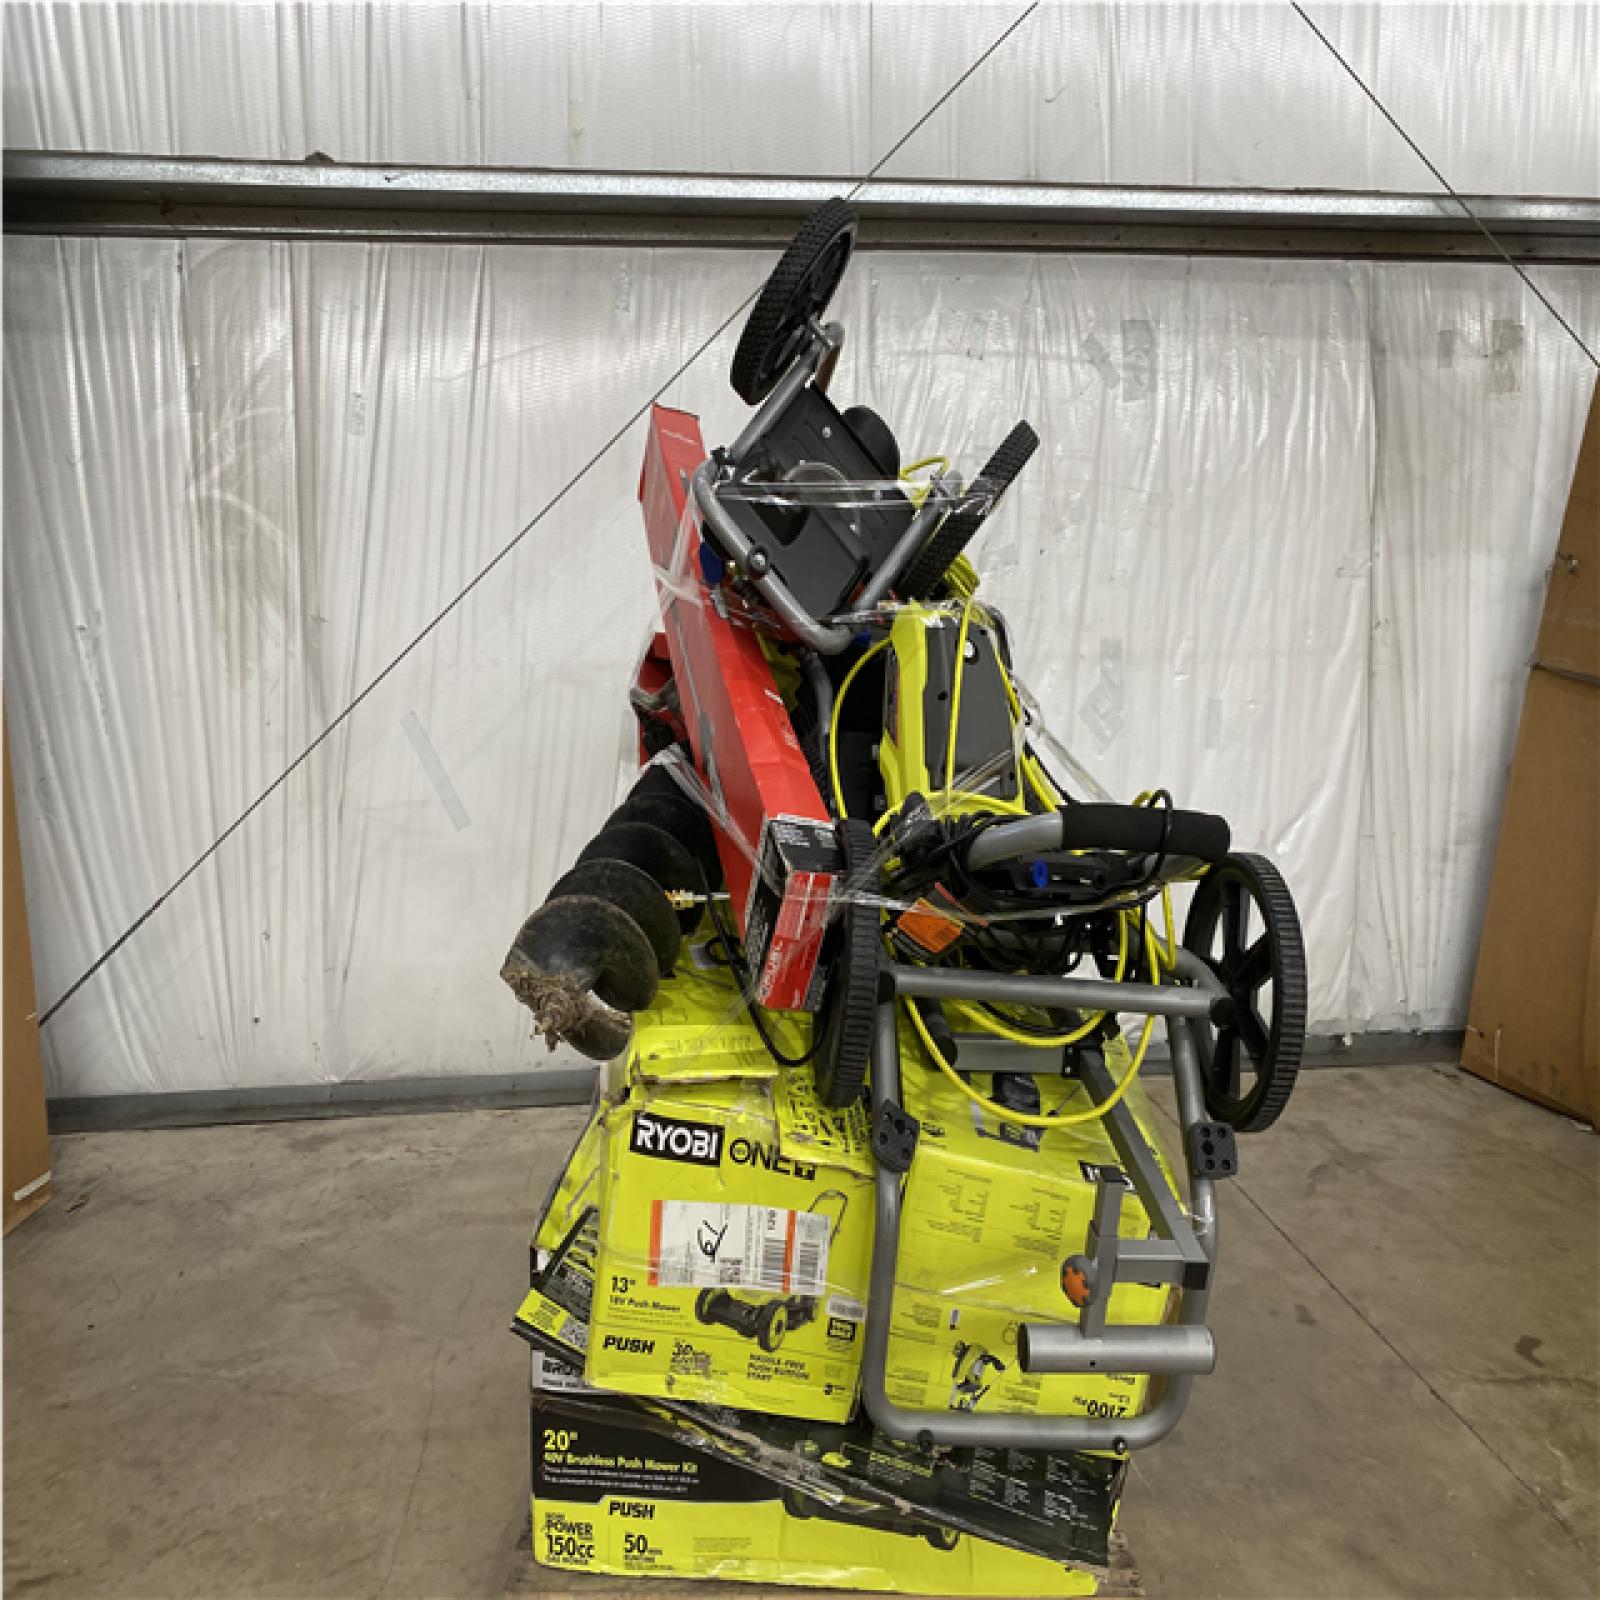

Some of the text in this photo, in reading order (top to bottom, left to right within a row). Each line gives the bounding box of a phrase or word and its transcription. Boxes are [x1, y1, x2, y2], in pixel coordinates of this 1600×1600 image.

[635, 1118, 719, 1160] RYOBI
[602, 1334, 656, 1356] PUSH
[543, 1429, 579, 1451] 20"
[566, 1453, 616, 1468] Brushless
[617, 1456, 643, 1469] Push
[644, 1459, 681, 1472] Mower
[608, 1500, 656, 1520] PUSH
[545, 1518, 593, 1536] POWER
[545, 1534, 596, 1559] 150cc
[624, 1533, 648, 1554] 50
